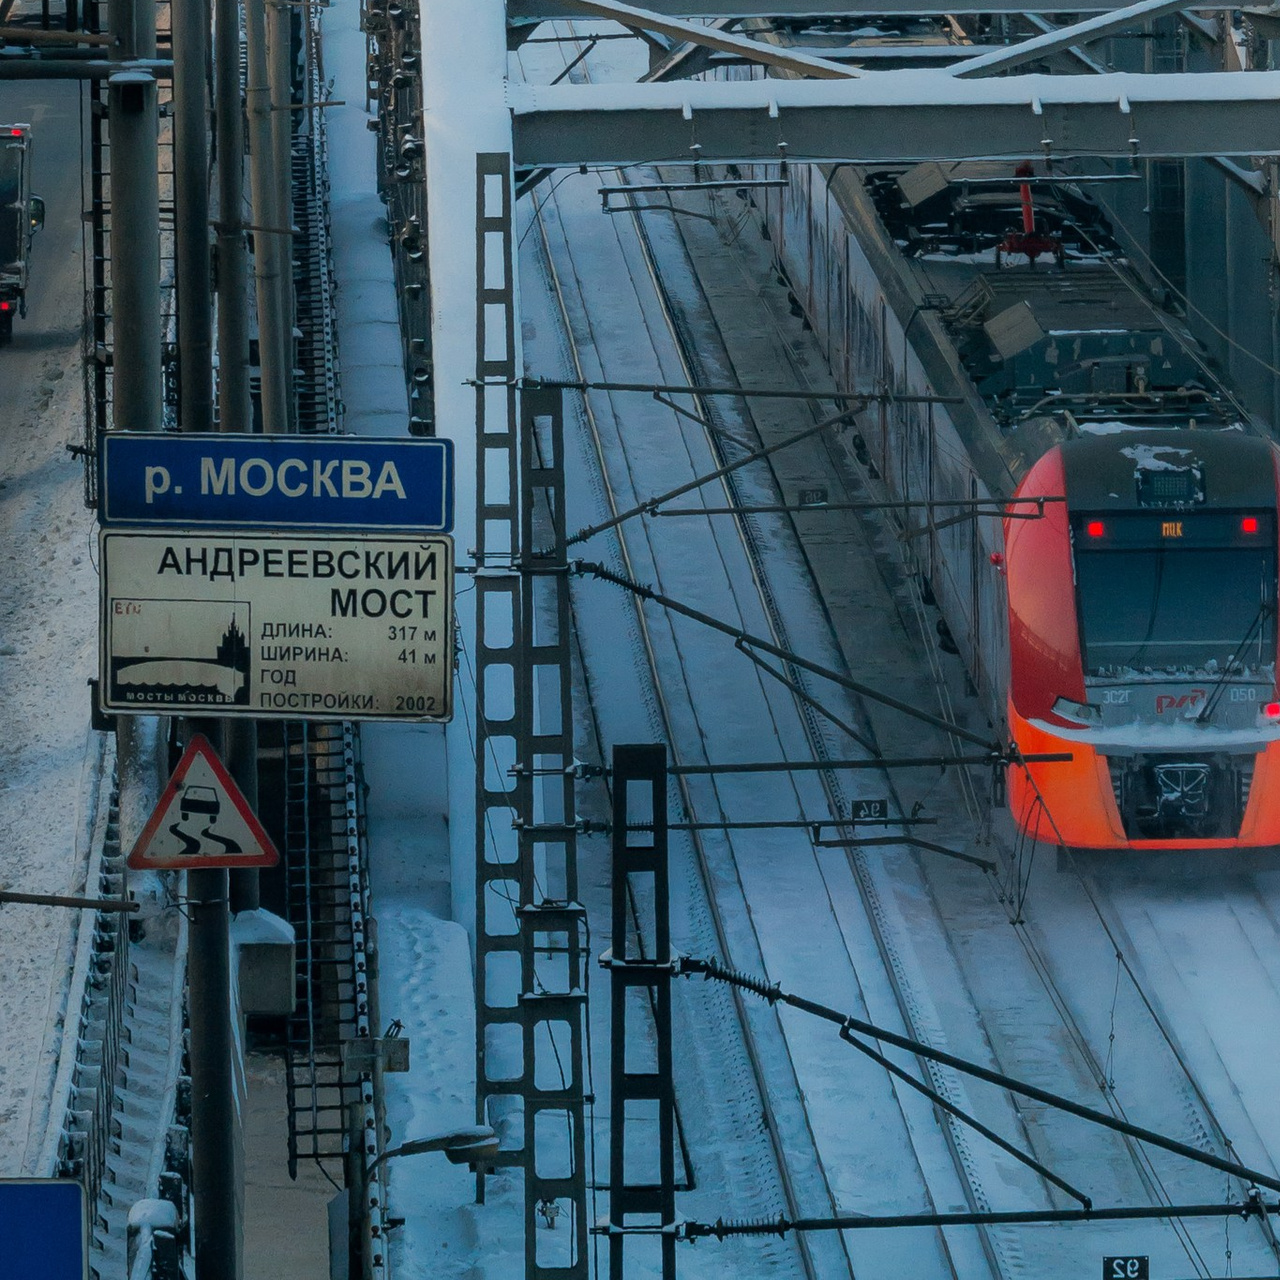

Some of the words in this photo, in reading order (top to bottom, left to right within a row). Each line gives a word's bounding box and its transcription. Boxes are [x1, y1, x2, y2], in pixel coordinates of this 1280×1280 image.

[145, 465, 183, 503] р.
[200, 457, 407, 500] МОСКВА
[157, 545, 437, 582] АНДРЕЕВСКИЙ
[331, 588, 437, 619] МОСТ
[261, 622, 333, 640] ДЛИНА:
[388, 625, 418, 641] 317
[424, 630, 437, 641] м
[261, 645, 349, 663] ШИРИНА:
[397, 648, 417, 664] 41
[424, 653, 437, 664] м
[260, 668, 297, 687] ГОД
[126, 692, 174, 701] МОСТЫ
[260, 690, 380, 710] ПОСТРОЙКИ:
[395, 695, 436, 711] 2002
